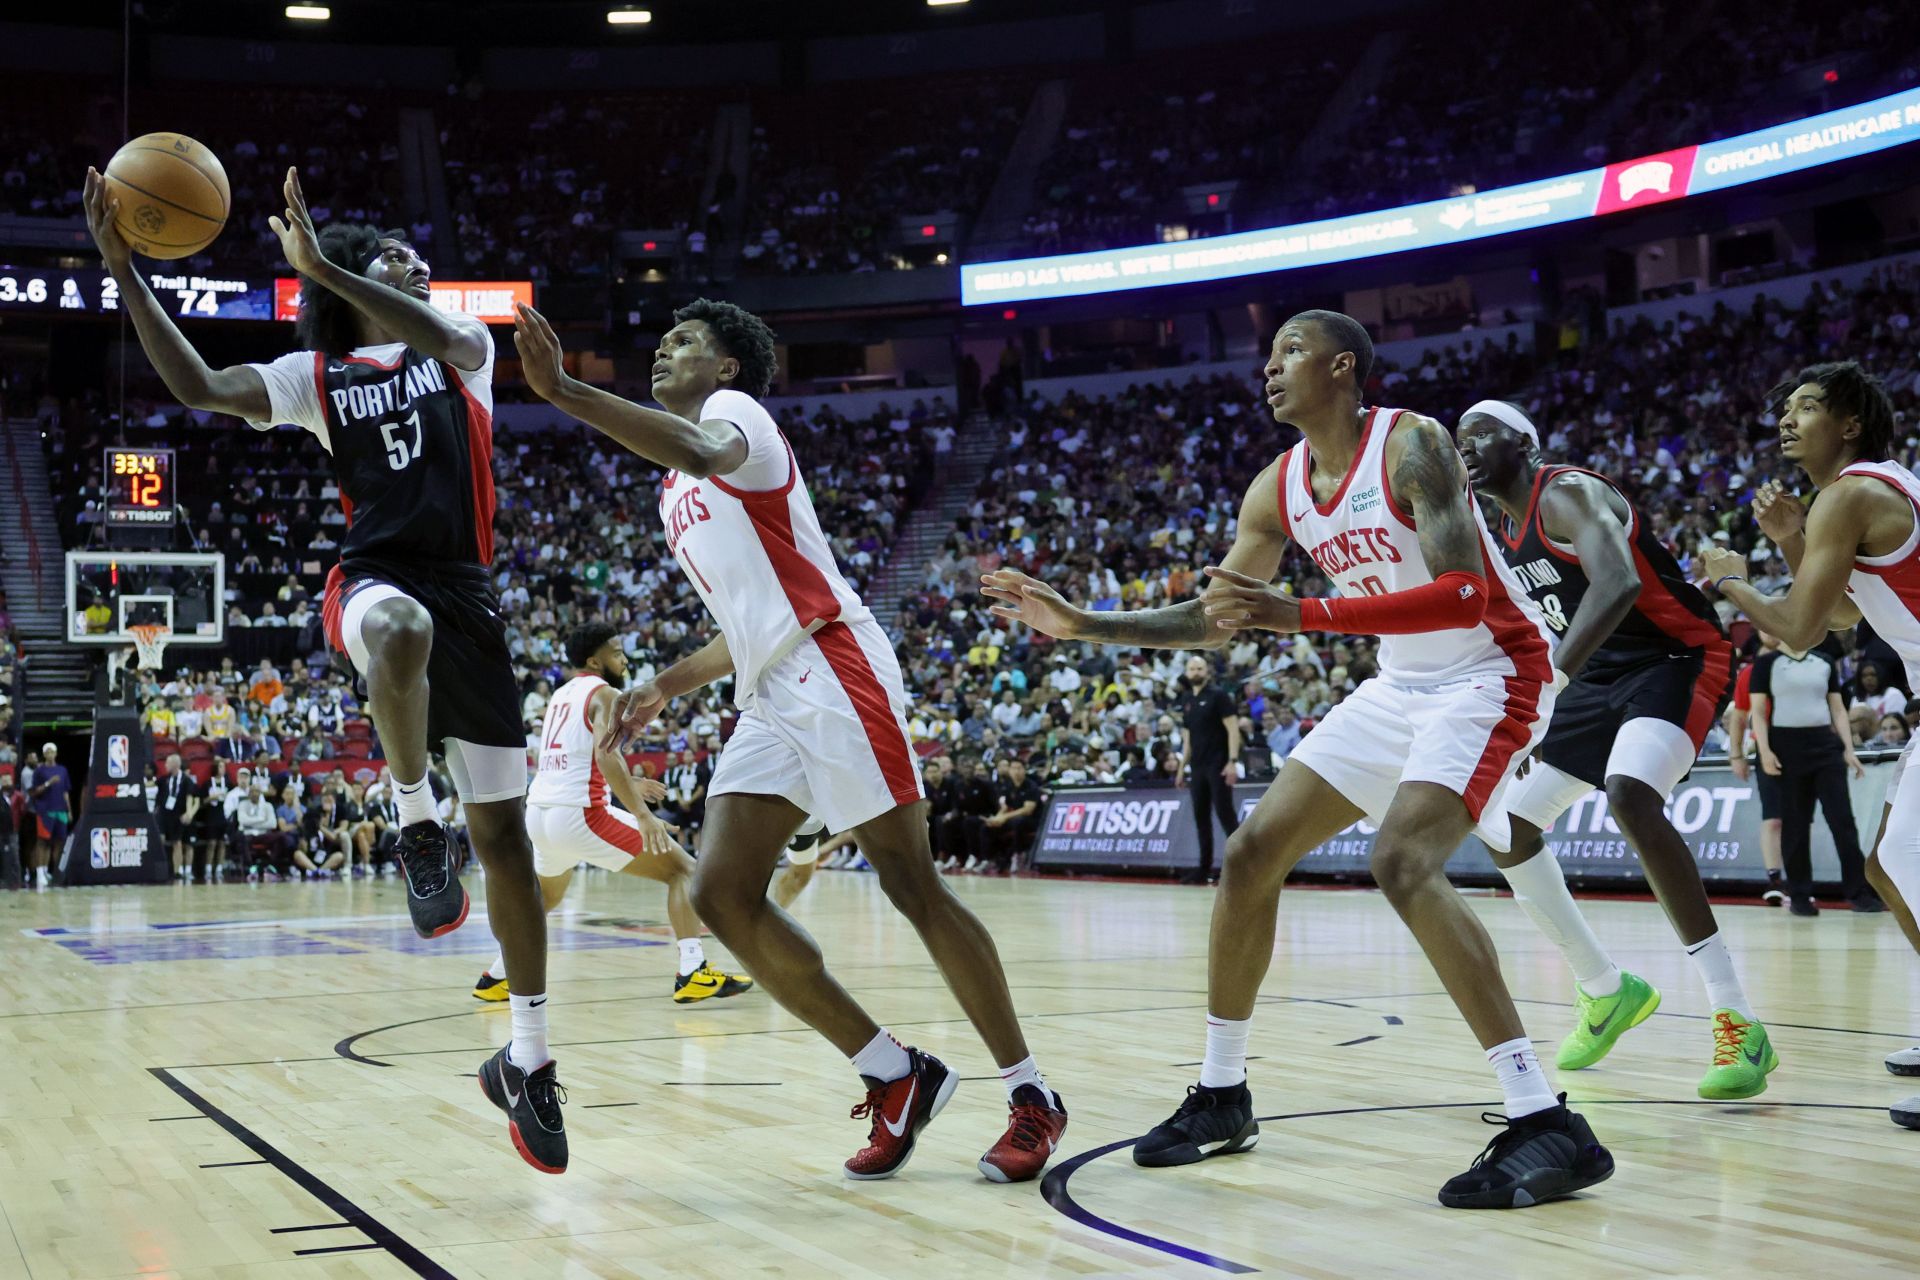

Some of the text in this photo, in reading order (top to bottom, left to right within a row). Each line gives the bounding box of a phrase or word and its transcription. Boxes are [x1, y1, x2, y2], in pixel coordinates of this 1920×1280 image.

[1704, 141, 1784, 175] OFFICIAL
[1785, 106, 1902, 156] HEALTHCARE
[151, 274, 248, 293] Trail Blazers
[1027, 267, 1059, 286] LAS
[62, 279, 78, 297] 9
[101, 277, 119, 299] 2
[176, 290, 219, 316] 74
[329, 357, 448, 428] PORTLAND
[379, 409, 424, 471] 57
[115, 453, 155, 475] 33.4
[132, 473, 162, 507] 12
[1351, 486, 1380, 503] credit
[127, 510, 172, 521] TISSOT
[1351, 498, 1382, 514] karma
[1310, 527, 1403, 578] ROCKETS
[681, 546, 713, 594] 1
[544, 702, 572, 751] 12
[1083, 800, 1181, 835] TISSOT
[1115, 839, 1145, 852] SINCE
[1327, 839, 1368, 856] SINCE
[1698, 841, 1741, 861] 1853
